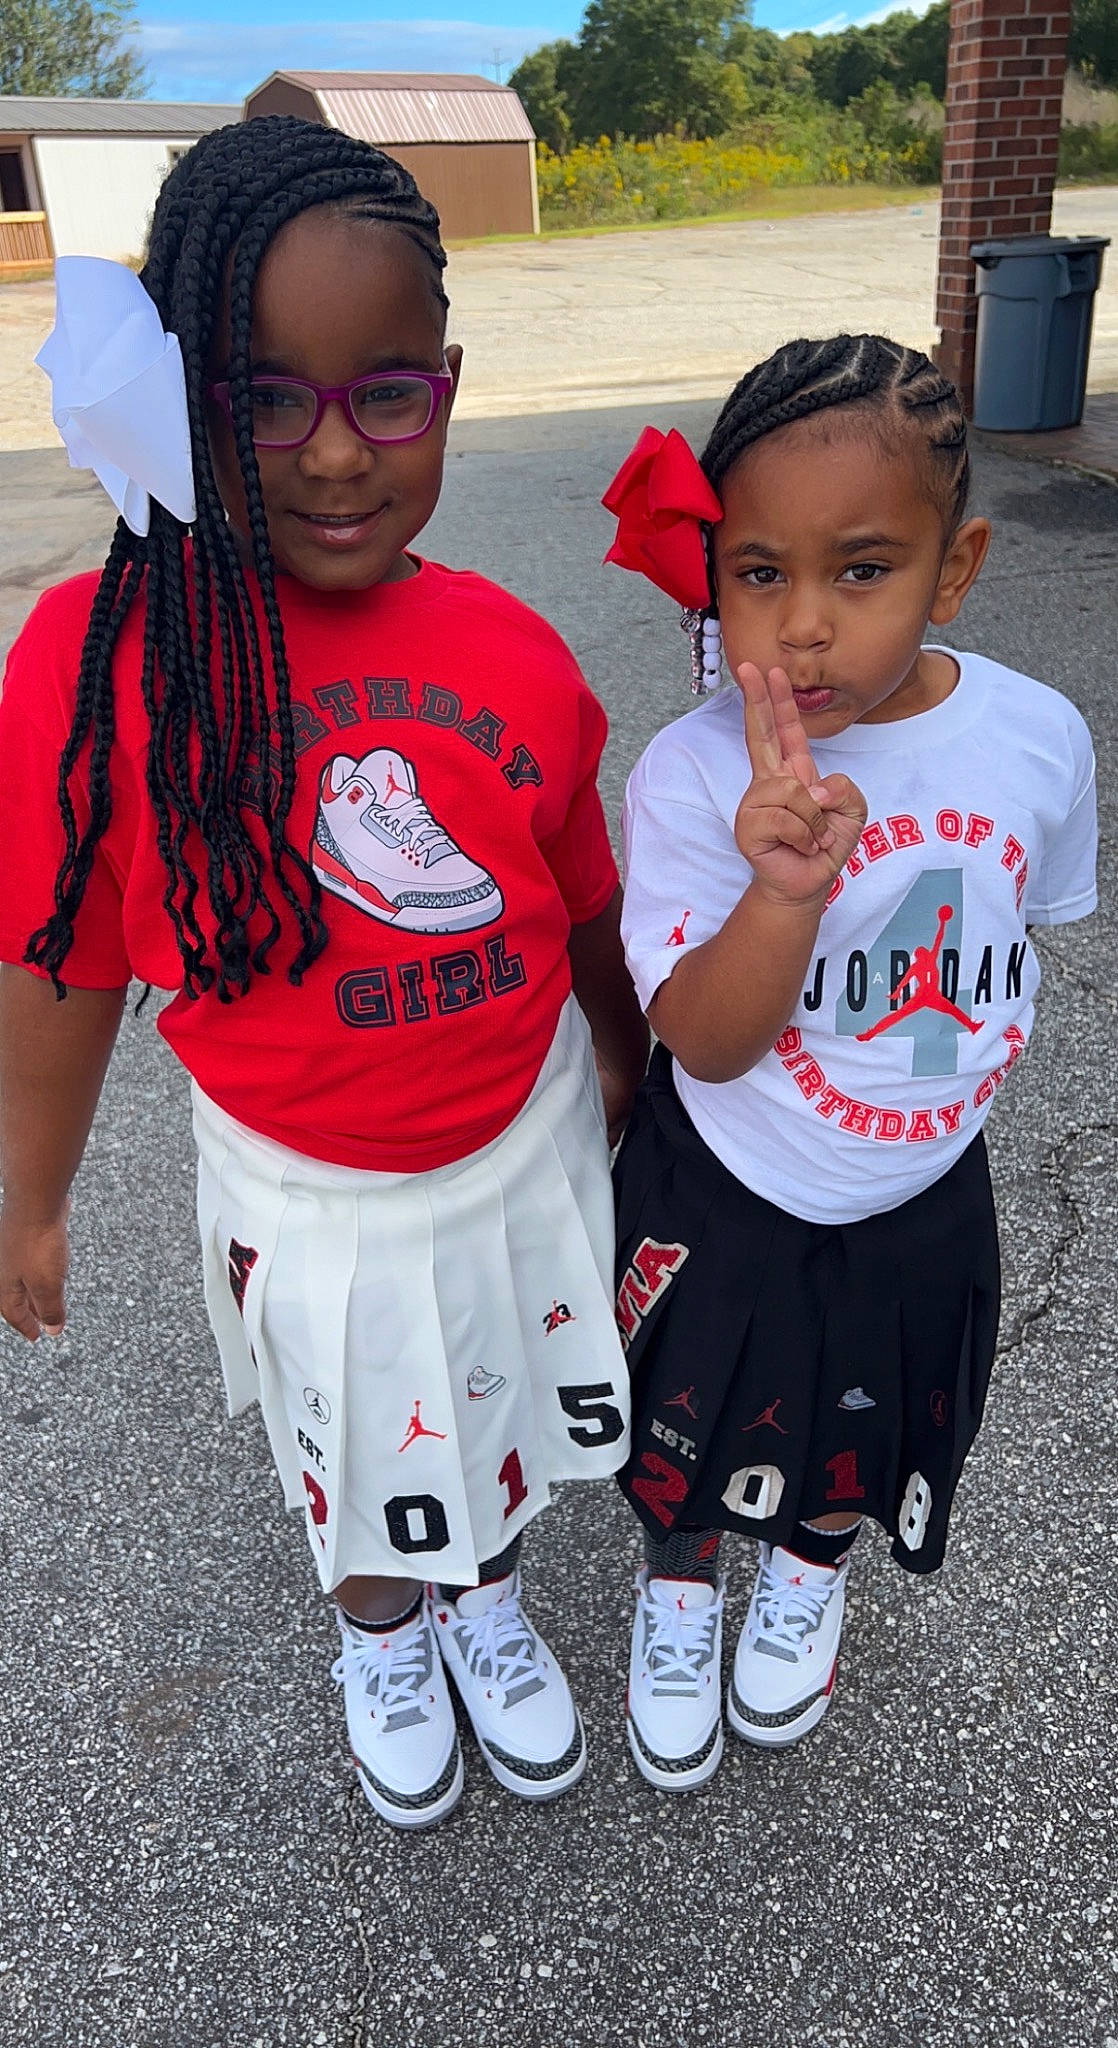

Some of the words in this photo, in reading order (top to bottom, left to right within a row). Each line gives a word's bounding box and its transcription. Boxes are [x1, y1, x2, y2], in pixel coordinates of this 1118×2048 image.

[936, 808, 994, 848] OF
[335, 938, 528, 1029] GIRL
[803, 941, 1026, 1012] JORDAN
[773, 1025, 965, 1142] BIRTHDAY
[297, 1427, 326, 1472] EST.
[383, 1494, 450, 1554] 0
[498, 1447, 528, 1519] 1
[556, 1382, 625, 1448] 5
[650, 1418, 697, 1461] EST.
[631, 1451, 689, 1528] 2
[721, 1465, 785, 1519] 0
[825, 1450, 865, 1500] 1
[899, 1471, 932, 1551] 8
